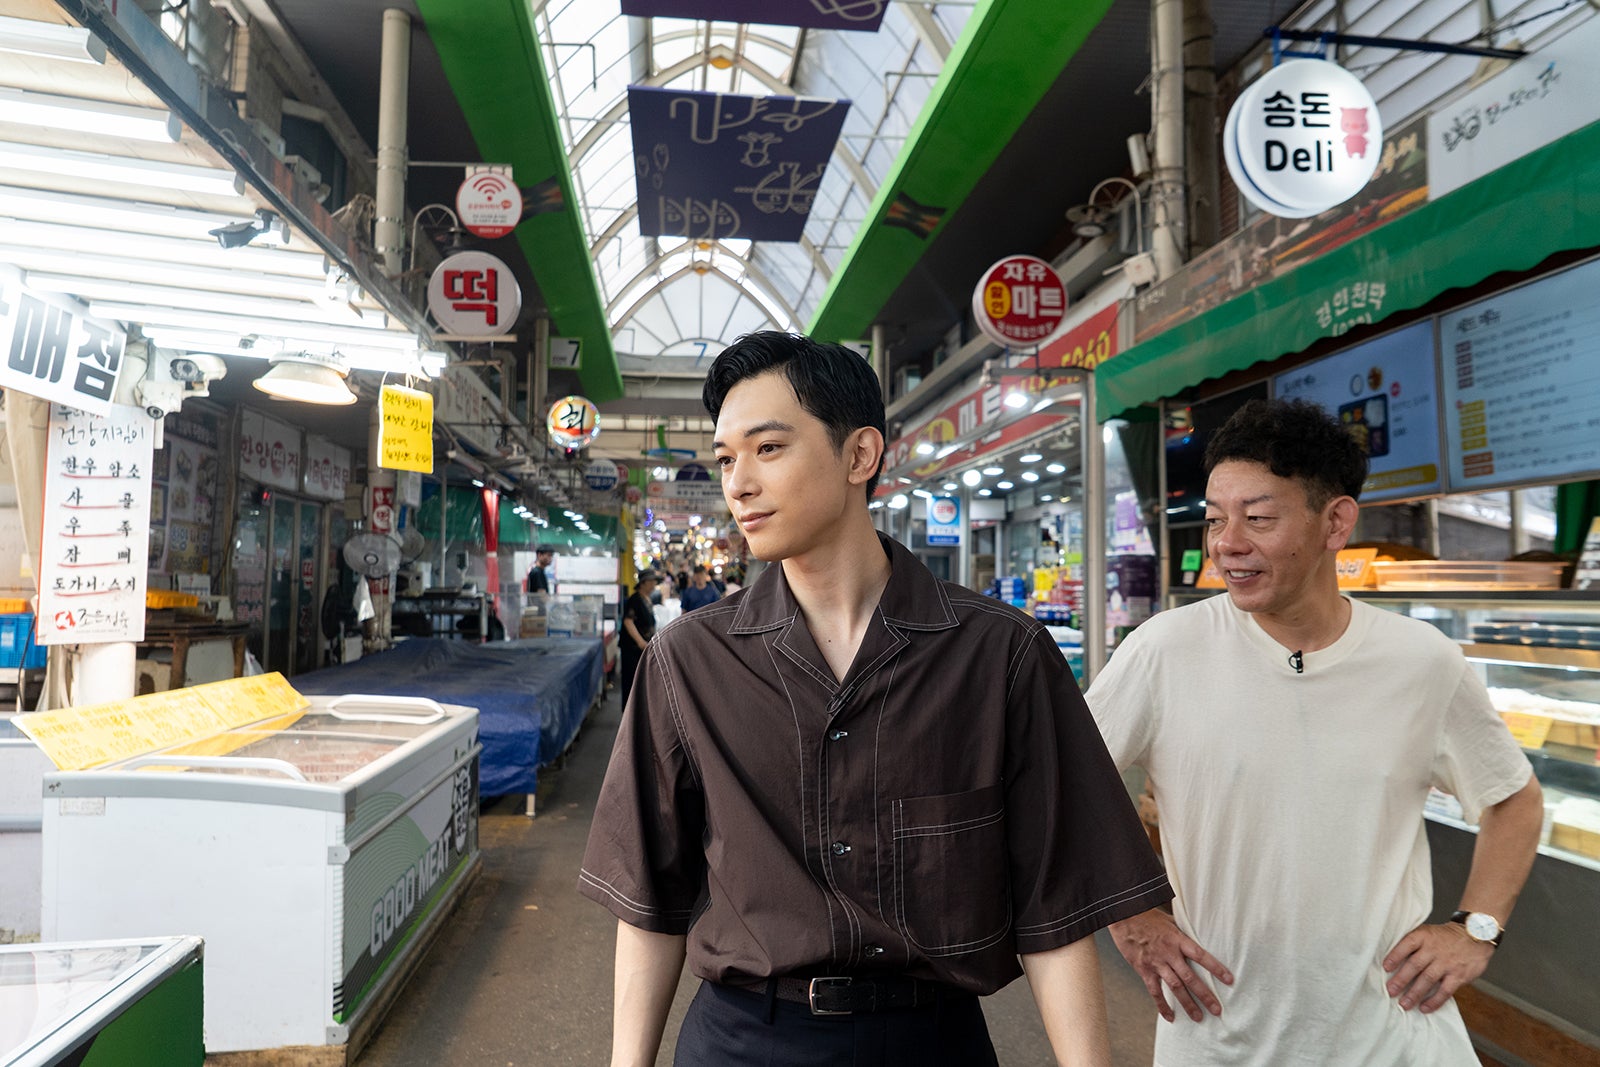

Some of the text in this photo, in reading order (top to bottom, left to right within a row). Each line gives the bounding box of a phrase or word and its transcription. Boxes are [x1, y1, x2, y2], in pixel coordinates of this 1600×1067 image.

[1263, 90, 1331, 128] 송돈
[1264, 140, 1333, 172] Deli
[1003, 262, 1047, 282] 자유
[443, 268, 498, 326] 떡
[1011, 285, 1063, 319] 마트
[568, 340, 580, 366] 7
[693, 342, 708, 366] 7
[62, 456, 141, 479] 한우 암소
[370, 831, 452, 957] GOOD MEAT
